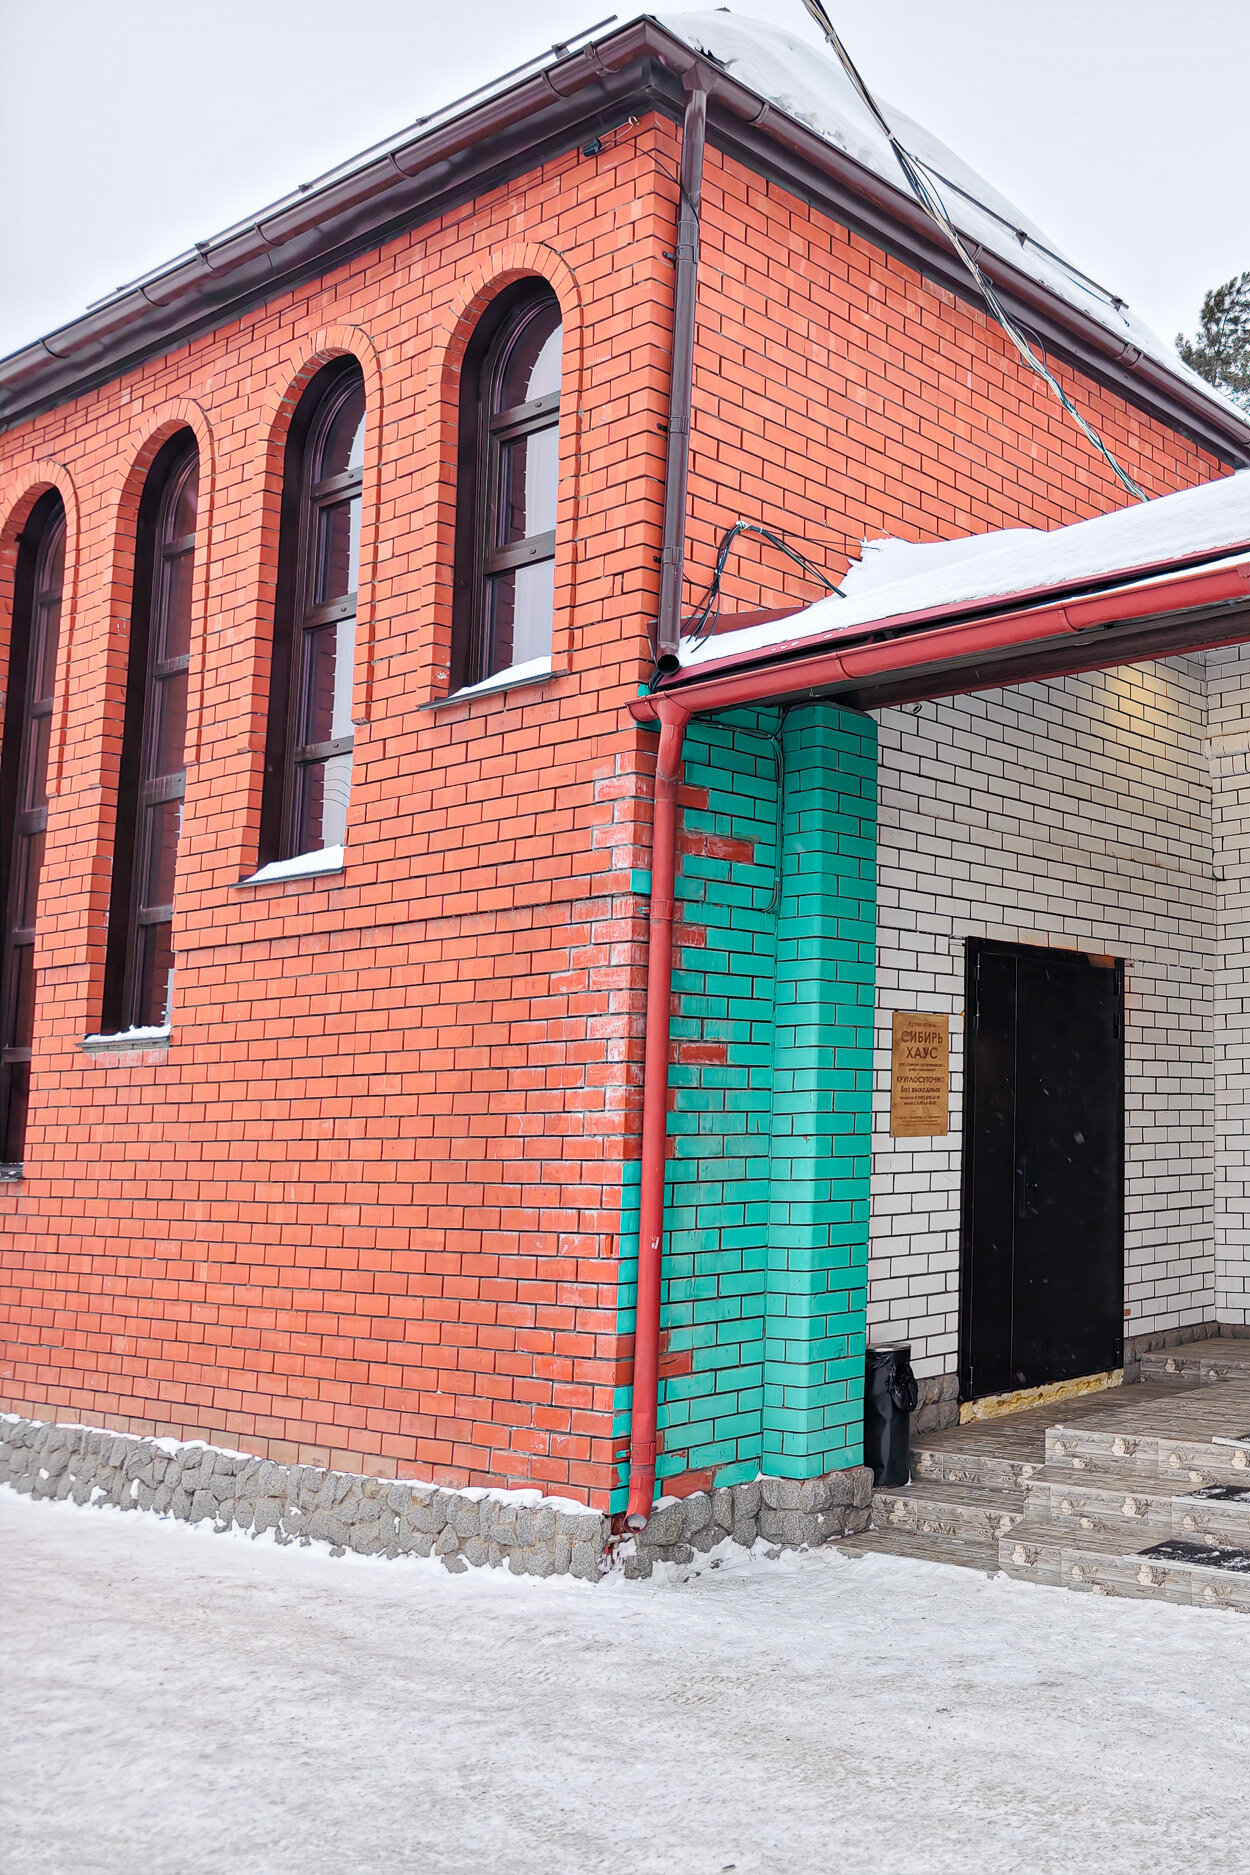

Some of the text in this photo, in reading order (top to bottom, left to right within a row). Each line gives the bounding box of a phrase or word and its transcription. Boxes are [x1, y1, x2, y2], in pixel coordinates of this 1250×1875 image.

[901, 1030, 943, 1044] СИБИРЬ
[906, 1046, 938, 1060] ХАУС
[896, 1075, 945, 1084] КРУГЛОСУТОЧНО
